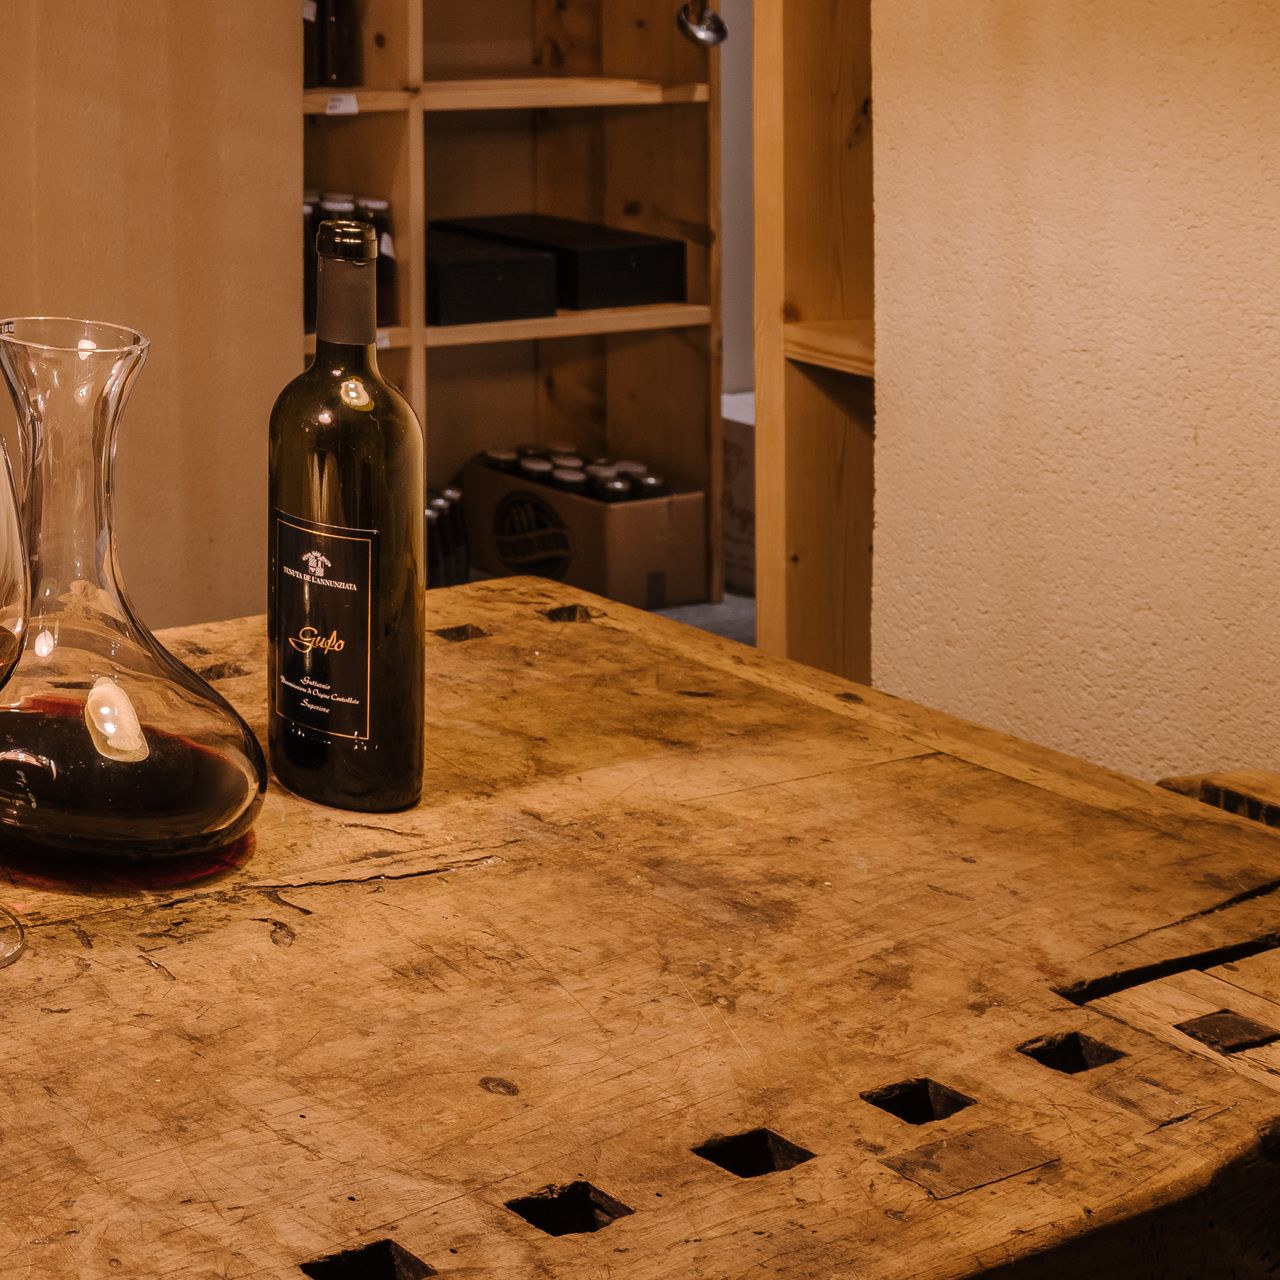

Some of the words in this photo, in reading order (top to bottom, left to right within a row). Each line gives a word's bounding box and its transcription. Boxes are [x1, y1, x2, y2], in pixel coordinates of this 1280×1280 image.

[283, 566, 302, 579] TENUTA
[302, 573, 311, 582] DE
[311, 576, 357, 591] L'ANNUNZIATA
[288, 626, 346, 654] Gufo
